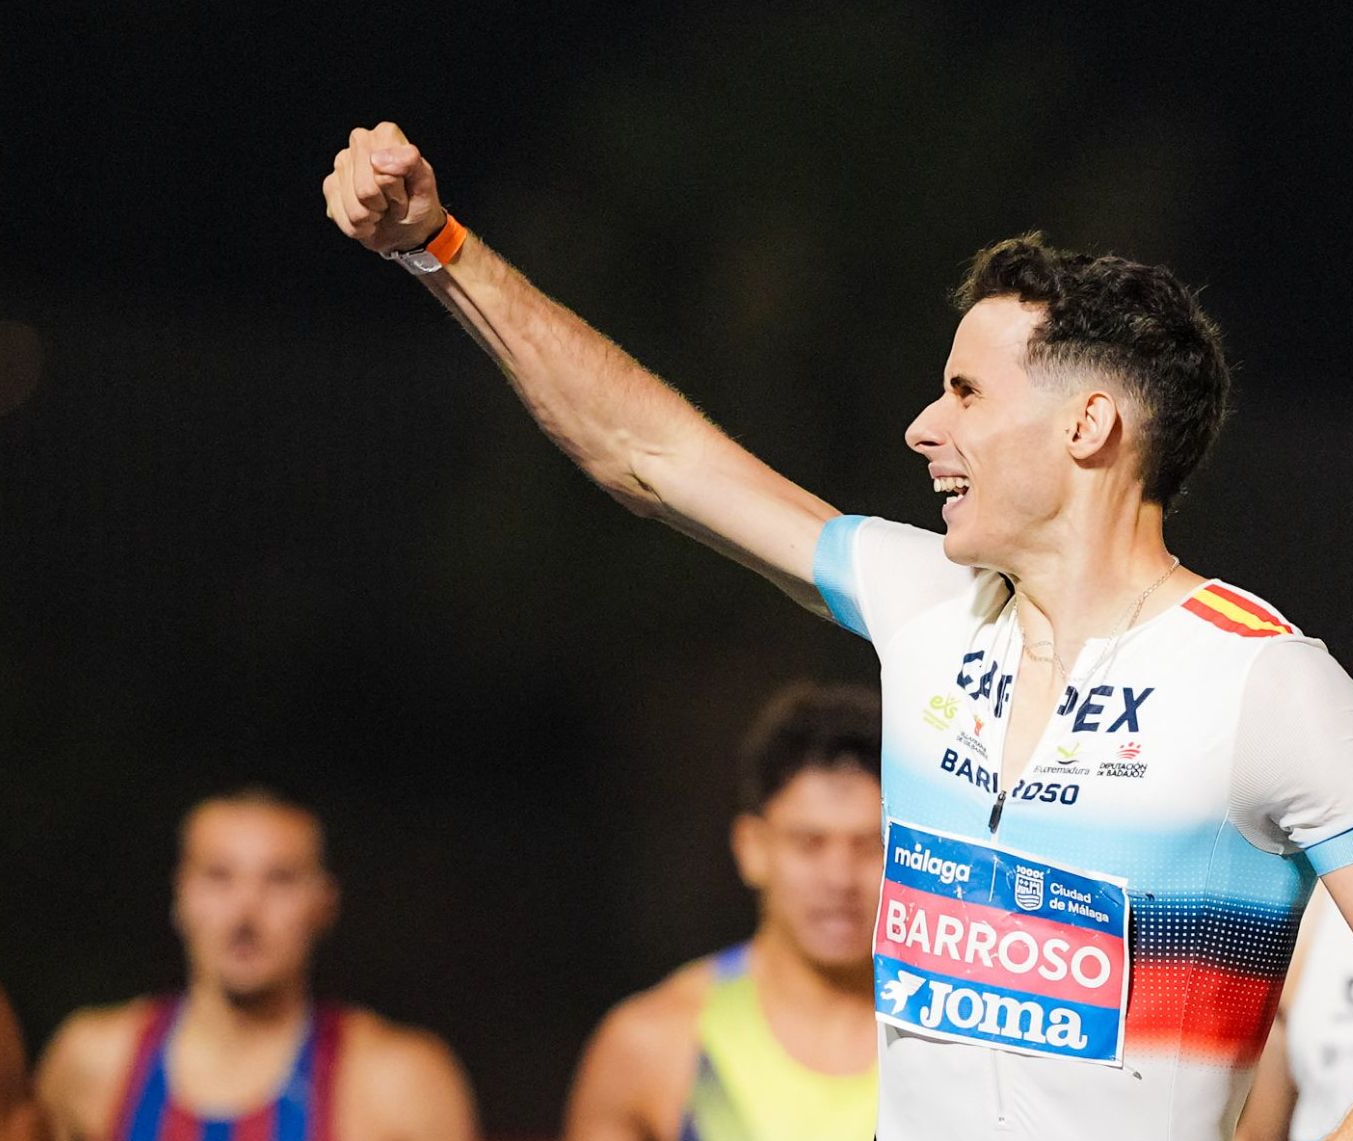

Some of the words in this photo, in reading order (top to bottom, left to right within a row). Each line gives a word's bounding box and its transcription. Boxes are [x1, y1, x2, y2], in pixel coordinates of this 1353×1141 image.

[1106, 768, 1145, 778] BADAJOZ
[1049, 882, 1091, 904] Ciudad
[1049, 897, 1065, 911] de
[1068, 900, 1109, 923] Málaga
[885, 899, 1111, 989] BARROSO
